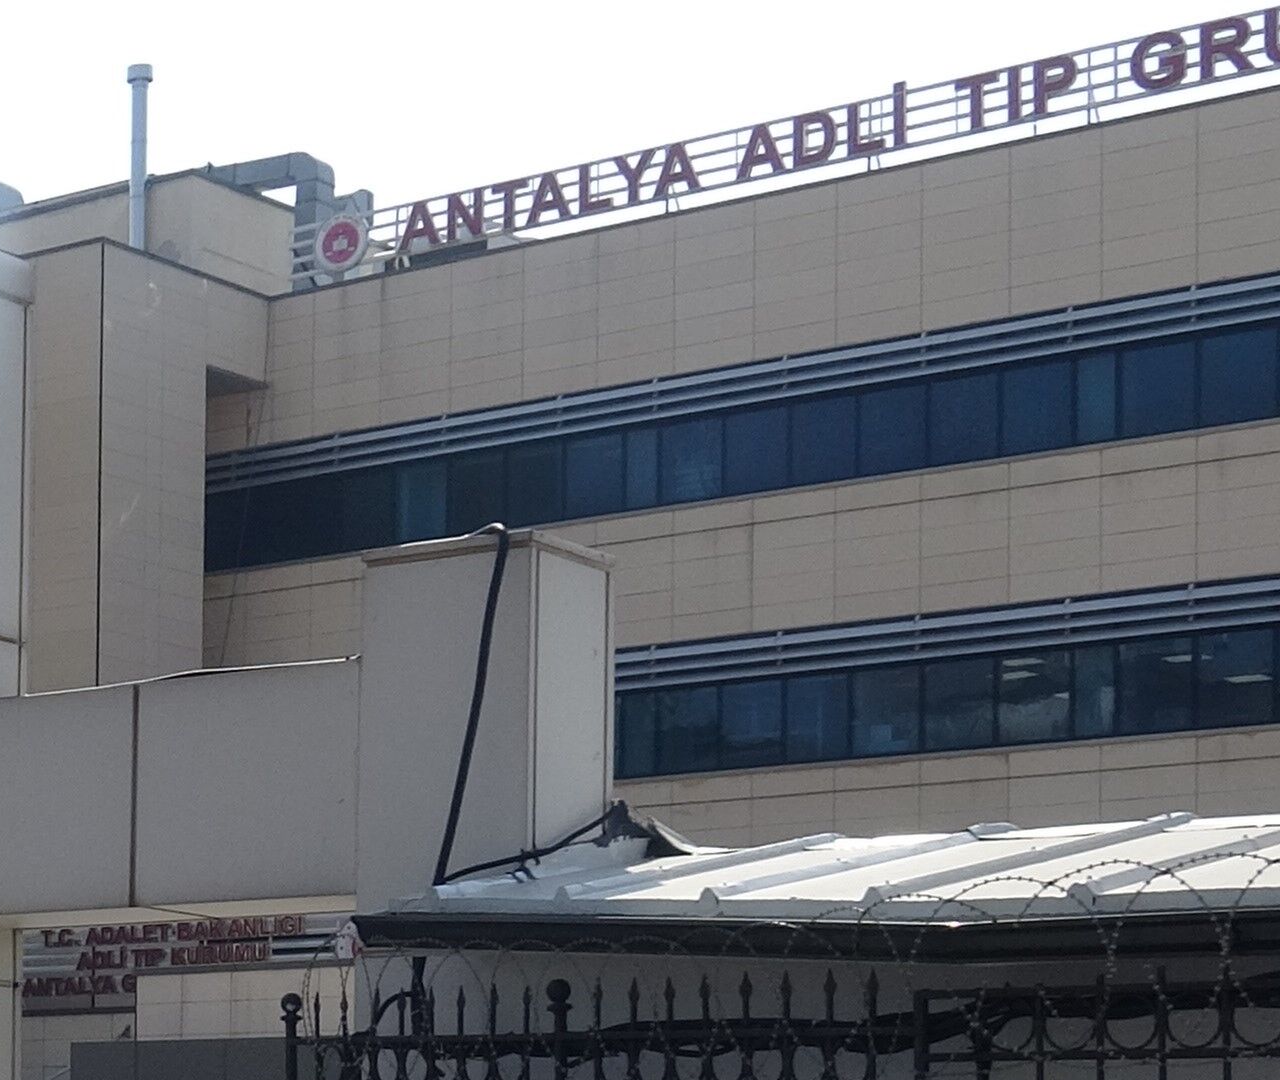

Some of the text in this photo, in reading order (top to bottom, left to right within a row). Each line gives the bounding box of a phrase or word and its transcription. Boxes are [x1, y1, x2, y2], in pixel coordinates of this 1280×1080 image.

[398, 142, 702, 253] ANTALYA
[737, 81, 908, 180] ADLİ
[954, 55, 1078, 131] TIP
[41, 929, 82, 948] T.C.
[85, 923, 175, 946] ADALET
[132, 947, 167, 967] TIP
[170, 942, 270, 966] KURUMU
[21, 975, 117, 998] ANTALYA
